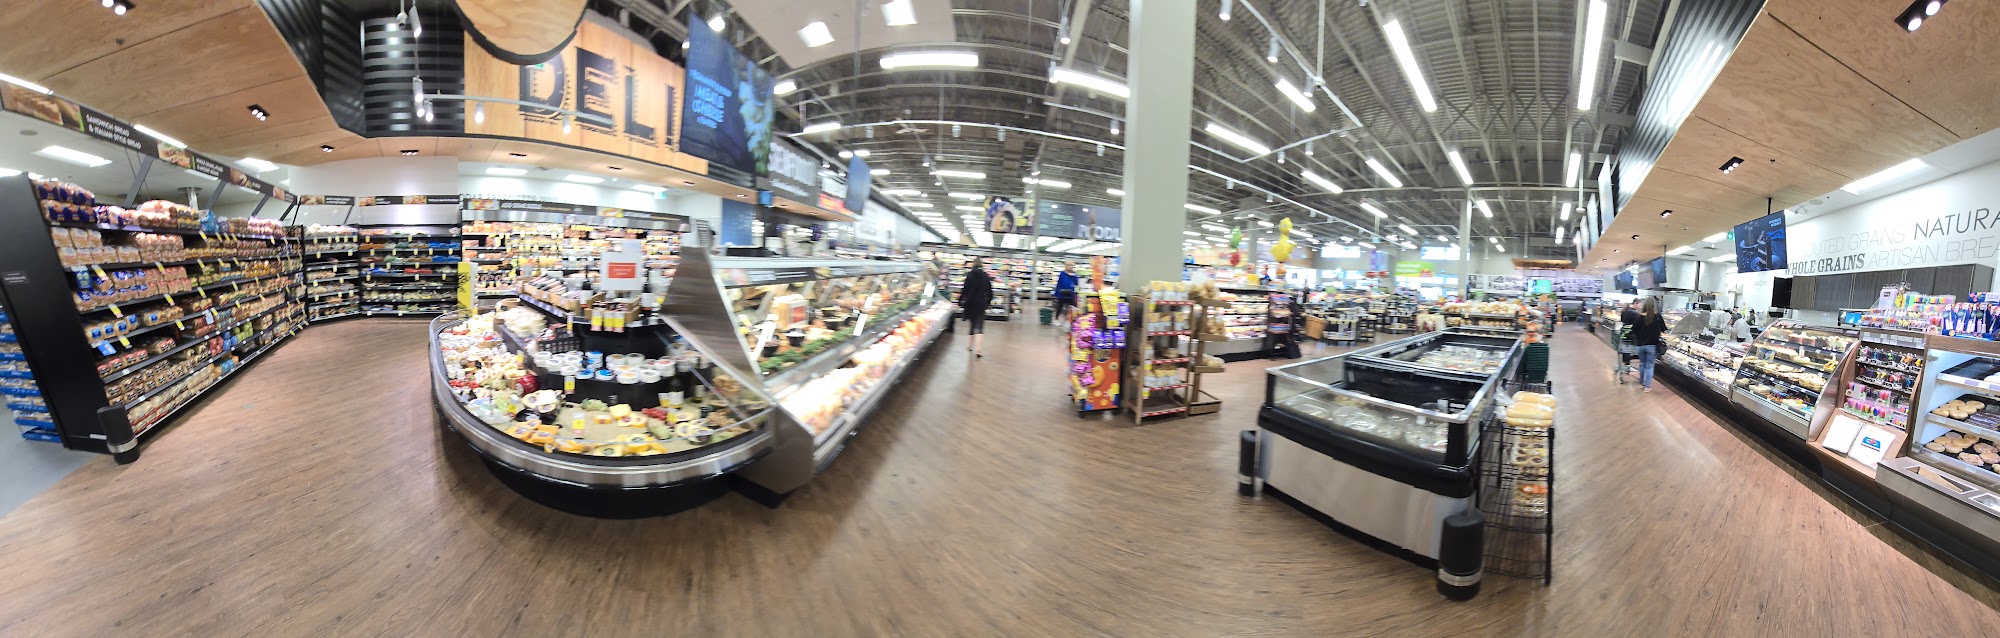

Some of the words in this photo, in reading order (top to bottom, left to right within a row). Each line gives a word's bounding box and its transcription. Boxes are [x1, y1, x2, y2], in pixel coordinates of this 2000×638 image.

[518, 45, 680, 152] DELI
[1847, 224, 1906, 251] GRAINS
[1817, 252, 1866, 273] GRAINS
[1867, 242, 1940, 269] ARTISAN
